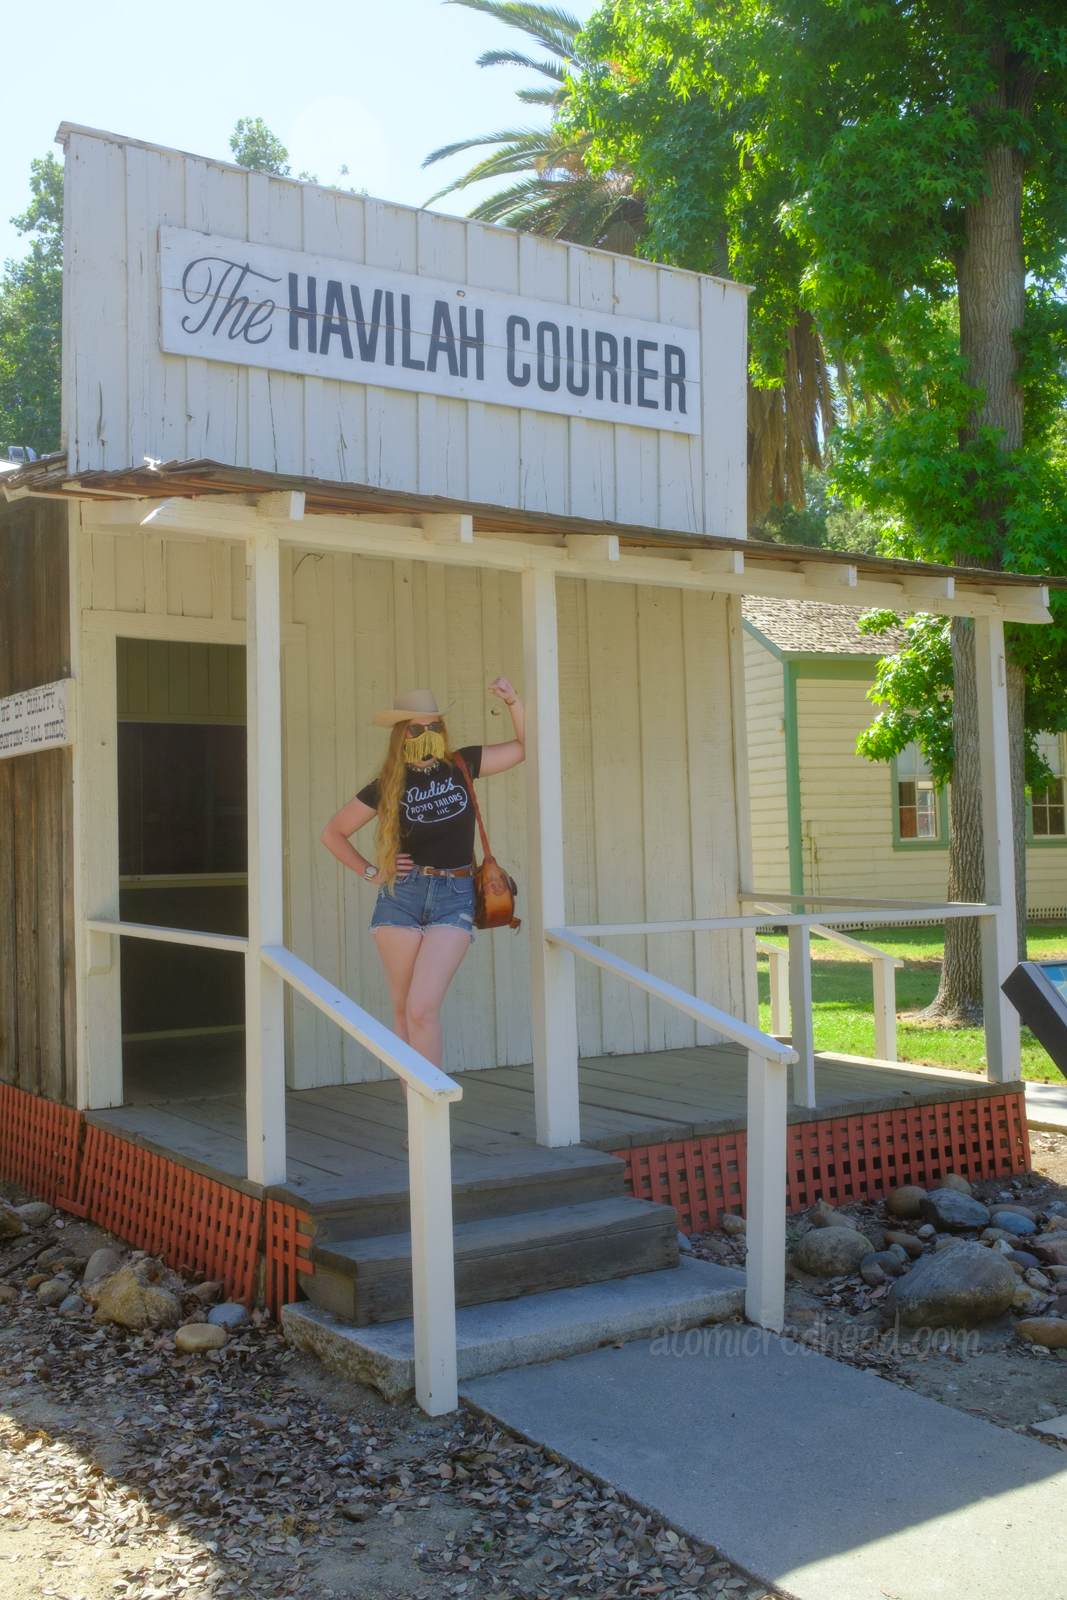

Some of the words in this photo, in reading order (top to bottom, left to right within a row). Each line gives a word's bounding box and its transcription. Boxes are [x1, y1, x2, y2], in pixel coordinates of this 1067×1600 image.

[181, 256, 282, 345] The
[288, 272, 485, 381] HAVILAH
[506, 314, 688, 414] COURIER
[15, 701, 23, 719] DO
[27, 691, 55, 715] QUALITY
[30, 724, 43, 743] ALL
[44, 719, 64, 740] KINDS
[406, 777, 455, 803] Nudie's
[434, 793, 462, 808] TAILORS
